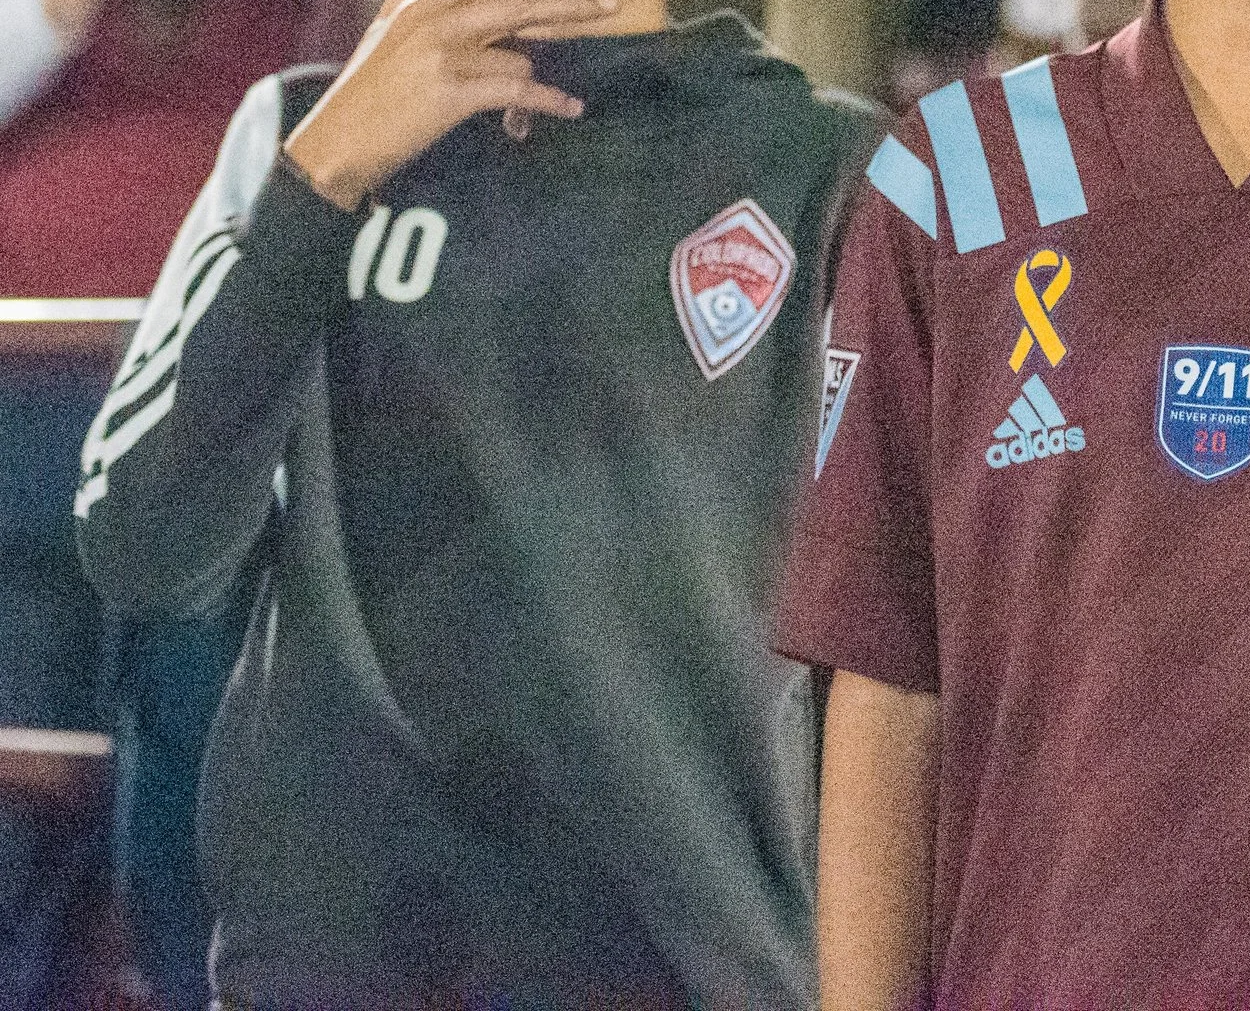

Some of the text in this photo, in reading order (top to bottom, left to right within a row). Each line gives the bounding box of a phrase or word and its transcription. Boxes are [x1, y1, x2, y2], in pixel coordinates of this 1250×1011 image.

[347, 205, 448, 302] 10
[1170, 410, 1207, 422] NEVER
[985, 426, 1086, 469] adidas
[1194, 429, 1227, 452] 20
